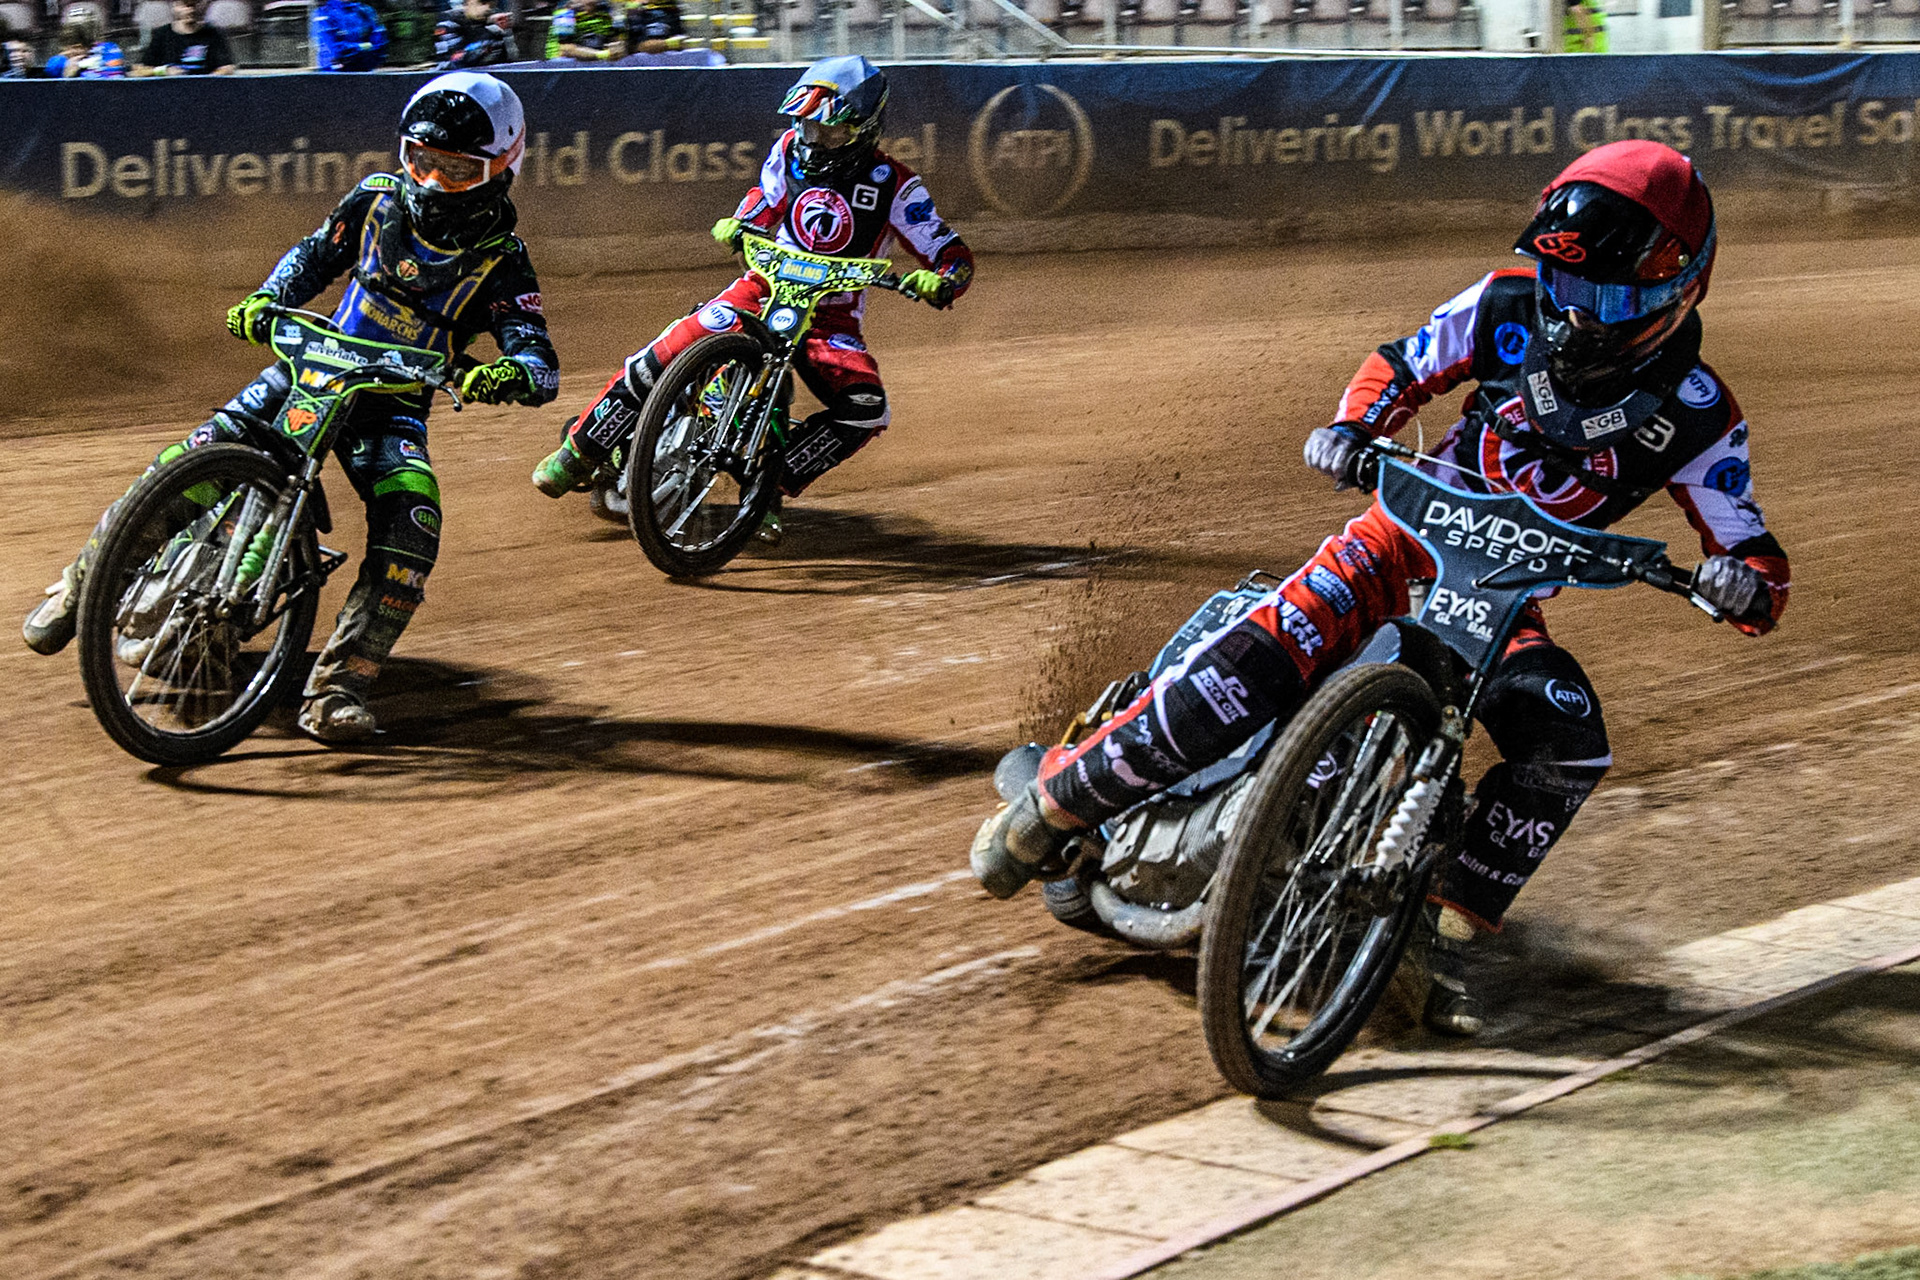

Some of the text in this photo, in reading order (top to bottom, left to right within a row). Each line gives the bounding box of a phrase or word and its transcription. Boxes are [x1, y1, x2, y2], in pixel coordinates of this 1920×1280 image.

[608, 129, 757, 185] Class
[1150, 112, 1401, 172] Delivering
[1413, 105, 1556, 157] World
[1704, 102, 1847, 151] Travel
[1687, 371, 1711, 399] ATPI
[1423, 500, 1594, 567] DAVIDOFF
[1444, 530, 1548, 573] SPEED
[1428, 587, 1492, 624] EYAS
[1198, 669, 1240, 722] ROCK OIL
[1554, 688, 1585, 706] ATPI
[1485, 800, 1555, 847] EYAS
